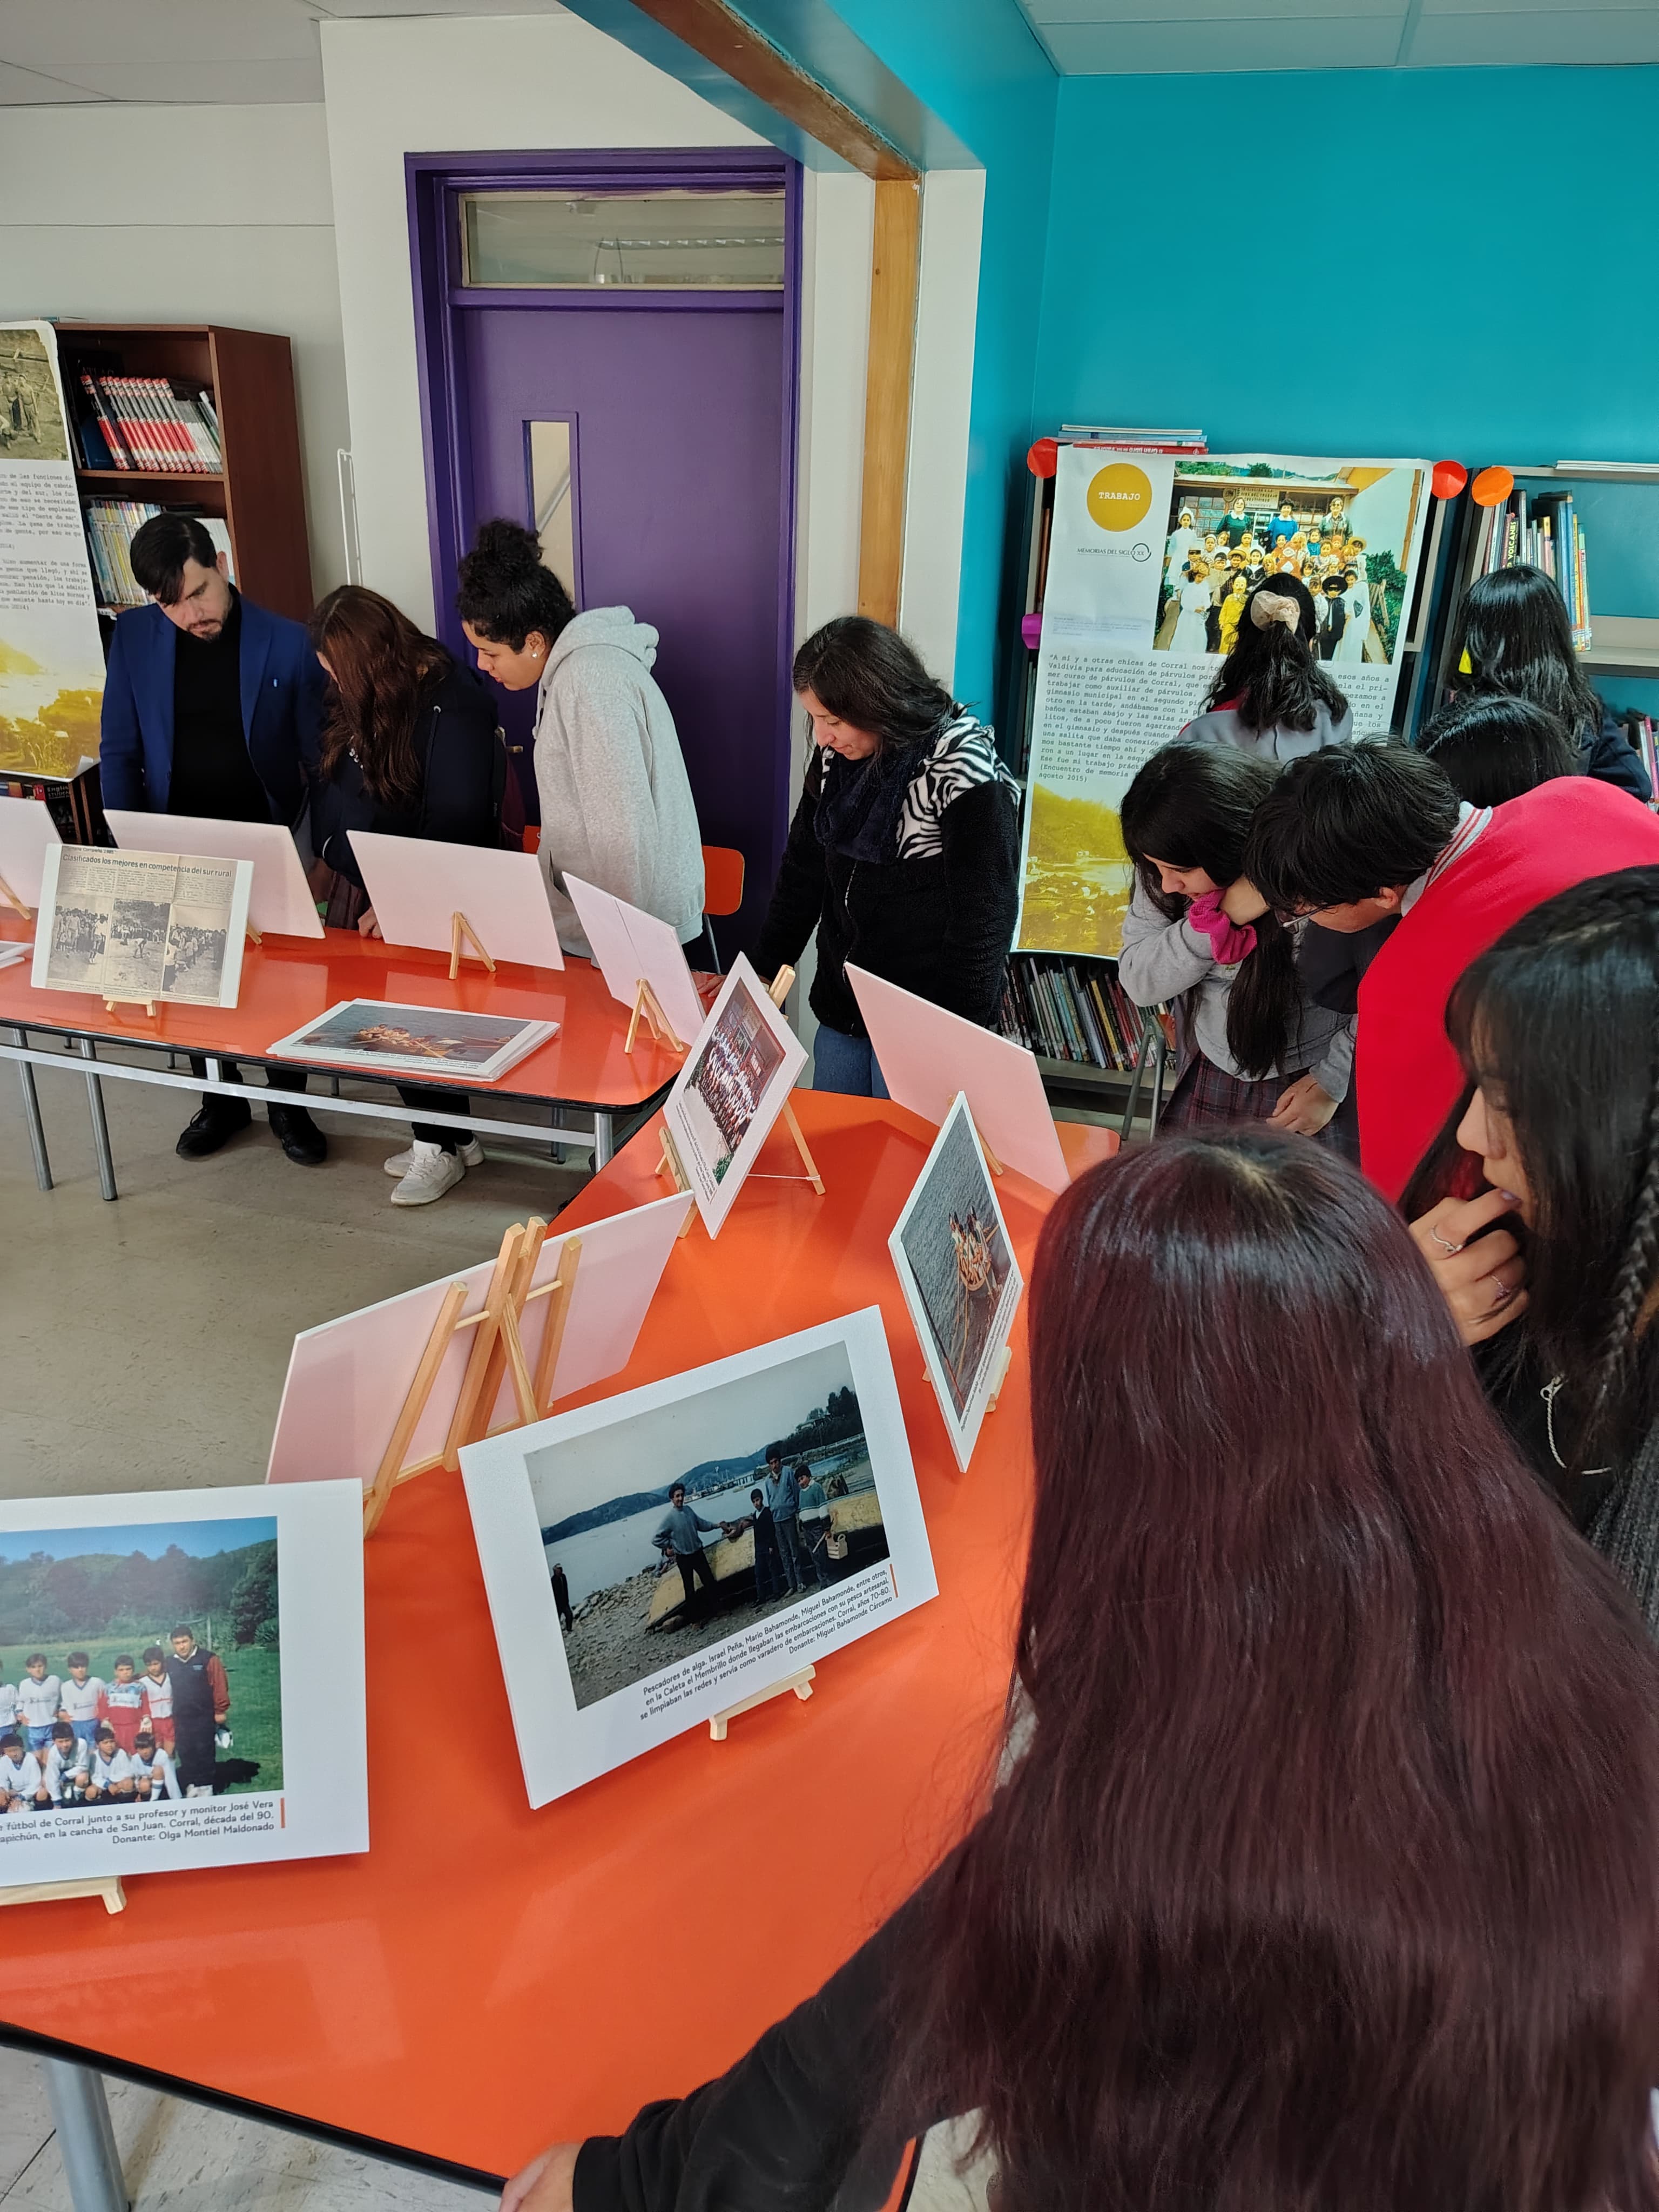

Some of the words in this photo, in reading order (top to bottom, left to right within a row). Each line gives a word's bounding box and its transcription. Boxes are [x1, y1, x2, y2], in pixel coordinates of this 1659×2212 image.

[1098, 492, 1141, 501] TRABAJO
[1508, 522, 1516, 561] VOLCANES
[1049, 663, 1082, 671] Valdivia
[1106, 667, 1145, 675] educación
[1159, 671, 1195, 679] párvulos
[1101, 675, 1135, 683] párvulos
[1046, 688, 1080, 697] gimnasio
[1047, 679, 1081, 688] trabajar
[1116, 719, 1141, 727] fueron
[63, 854, 101, 864] Clasificados
[112, 859, 138, 869] mejores
[148, 863, 190, 874] competencia
[643, 1673, 680, 1696] Pescadores
[682, 1668, 690, 1676] de
[692, 1661, 707, 1671] alga.
[709, 1648, 726, 1663] Israel
[727, 1642, 744, 1654] Peña,
[745, 1631, 763, 1644] Mario
[764, 1614, 800, 1635] Bahamonde,
[801, 1601, 821, 1616] Miguel
[821, 1586, 855, 1606] Bahamonde,
[856, 1577, 871, 1588] entre
[872, 1570, 887, 1581] otros,
[789, 1637, 815, 1654] Donante:
[816, 1624, 835, 1640] Miguel
[836, 1608, 868, 1629] Bahamonde
[869, 1596, 892, 1611] Cárcamo
[646, 1697, 654, 1705] en
[664, 1682, 685, 1696] Caleta
[687, 1675, 693, 1685] el
[694, 1660, 727, 1681] Membrillo
[728, 1650, 747, 1664] donde
[748, 1637, 774, 1654] llegaban
[774, 1632, 784, 1640] las
[785, 1610, 827, 1635] embarcaciones
[827, 1604, 838, 1613] con
[847, 1592, 862, 1606] pesca
[864, 1577, 889, 1595] artesanal,
[649, 1695, 682, 1715] limpiaban
[683, 1689, 693, 1698] las
[694, 1679, 712, 1692] redes
[713, 1676, 718, 1684] y
[719, 1665, 738, 1680] servía
[739, 1657, 756, 1669] como
[757, 1643, 784, 1660] varadero
[785, 1637, 792, 1645] de
[794, 1616, 837, 1641] embarcaciones.
[838, 1603, 857, 1618] Corral,
[857, 1598, 870, 1608] años
[870, 1586, 891, 1601] 70-80.
[6, 1820, 37, 1830] fútbol
[39, 1819, 51, 1827] de
[55, 1816, 84, 1826] Corral
[87, 1815, 113, 1826] junto
[139, 1809, 178, 1822] profesor
[181, 1809, 187, 1818] y
[190, 1805, 227, 1815] monitor
[229, 1801, 249, 1812] José
[252, 1800, 273, 1809] Vera
[0, 1832, 41, 1845] apichún,
[58, 1829, 67, 1837] la
[70, 1826, 103, 1836] cancha
[106, 1824, 118, 1833] de
[121, 1823, 139, 1832] San
[141, 1822, 166, 1831] Juan.
[169, 1817, 200, 1827] Corral,
[204, 1814, 237, 1825] década
[240, 1812, 254, 1822] del
[257, 1811, 274, 1820] 90.
[112, 1835, 155, 1844] Donante:
[158, 1831, 181, 1841] Olga
[184, 1826, 220, 1838] Montiel
[224, 1822, 274, 1834] Maldonado
